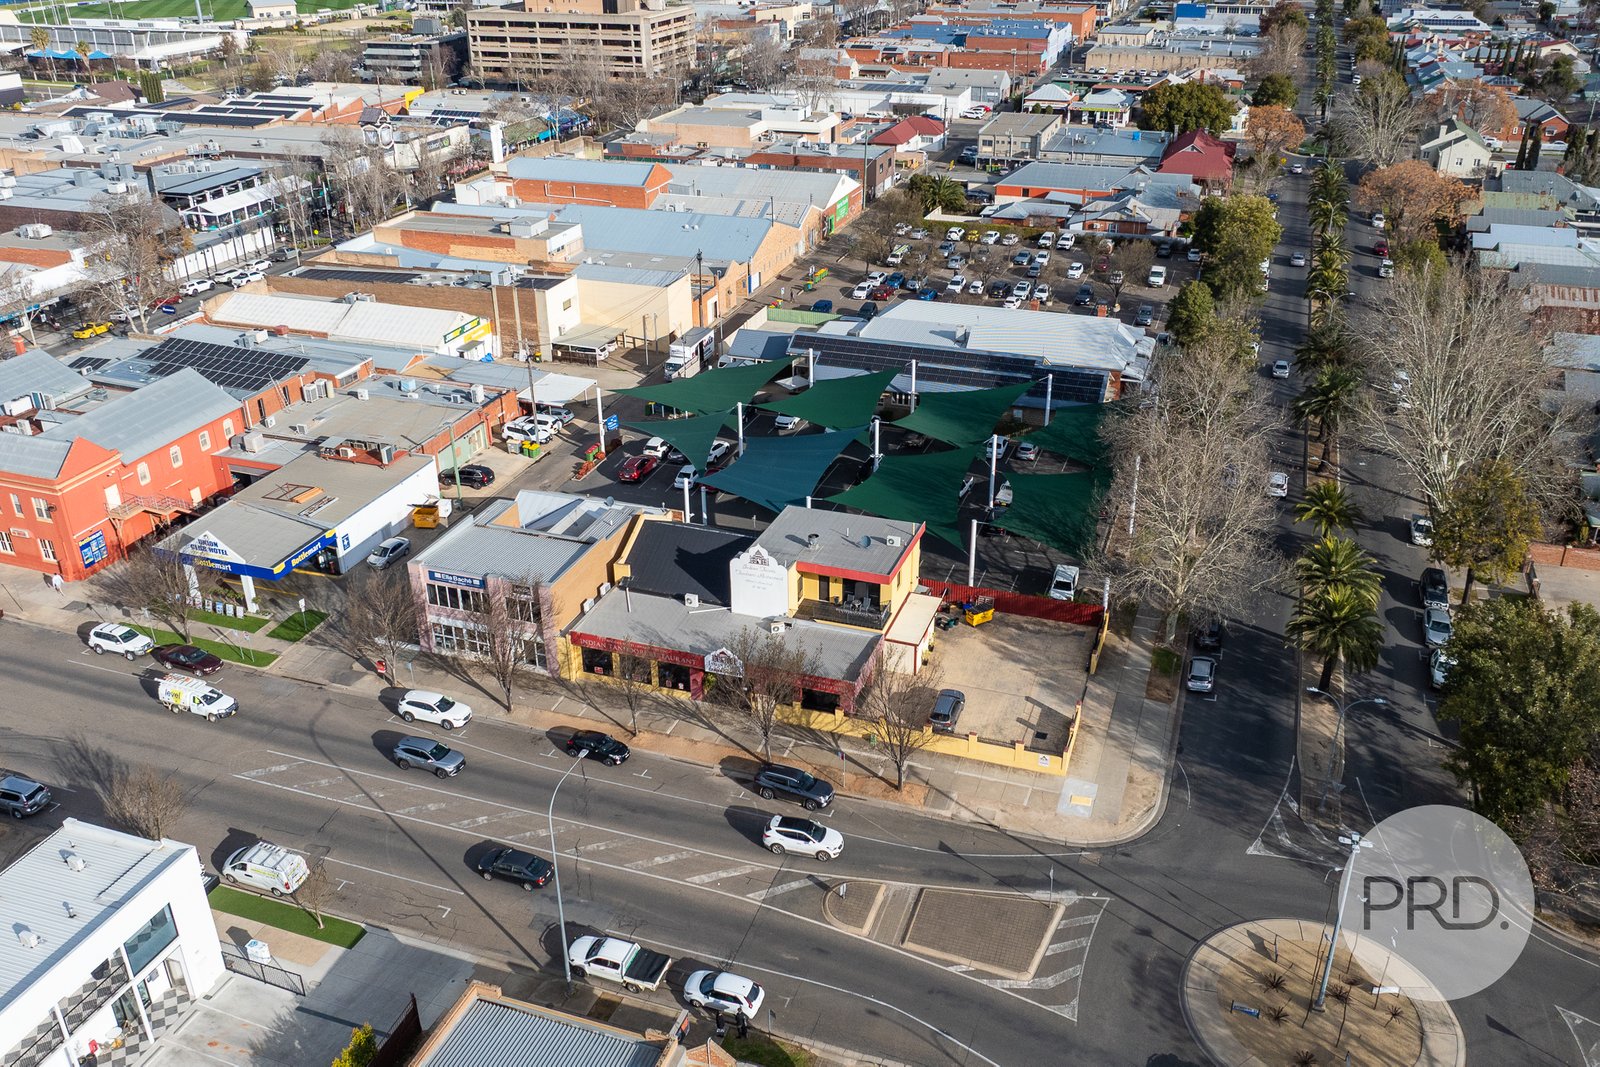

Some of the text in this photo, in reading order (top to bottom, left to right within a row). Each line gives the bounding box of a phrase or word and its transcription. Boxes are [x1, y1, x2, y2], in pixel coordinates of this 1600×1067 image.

[197, 538, 219, 548] UNION
[190, 543, 229, 556] CLUB HOTEL
[291, 541, 322, 567] Bottlemart
[580, 639, 607, 649] INDIAN
[165, 688, 181, 699] level
